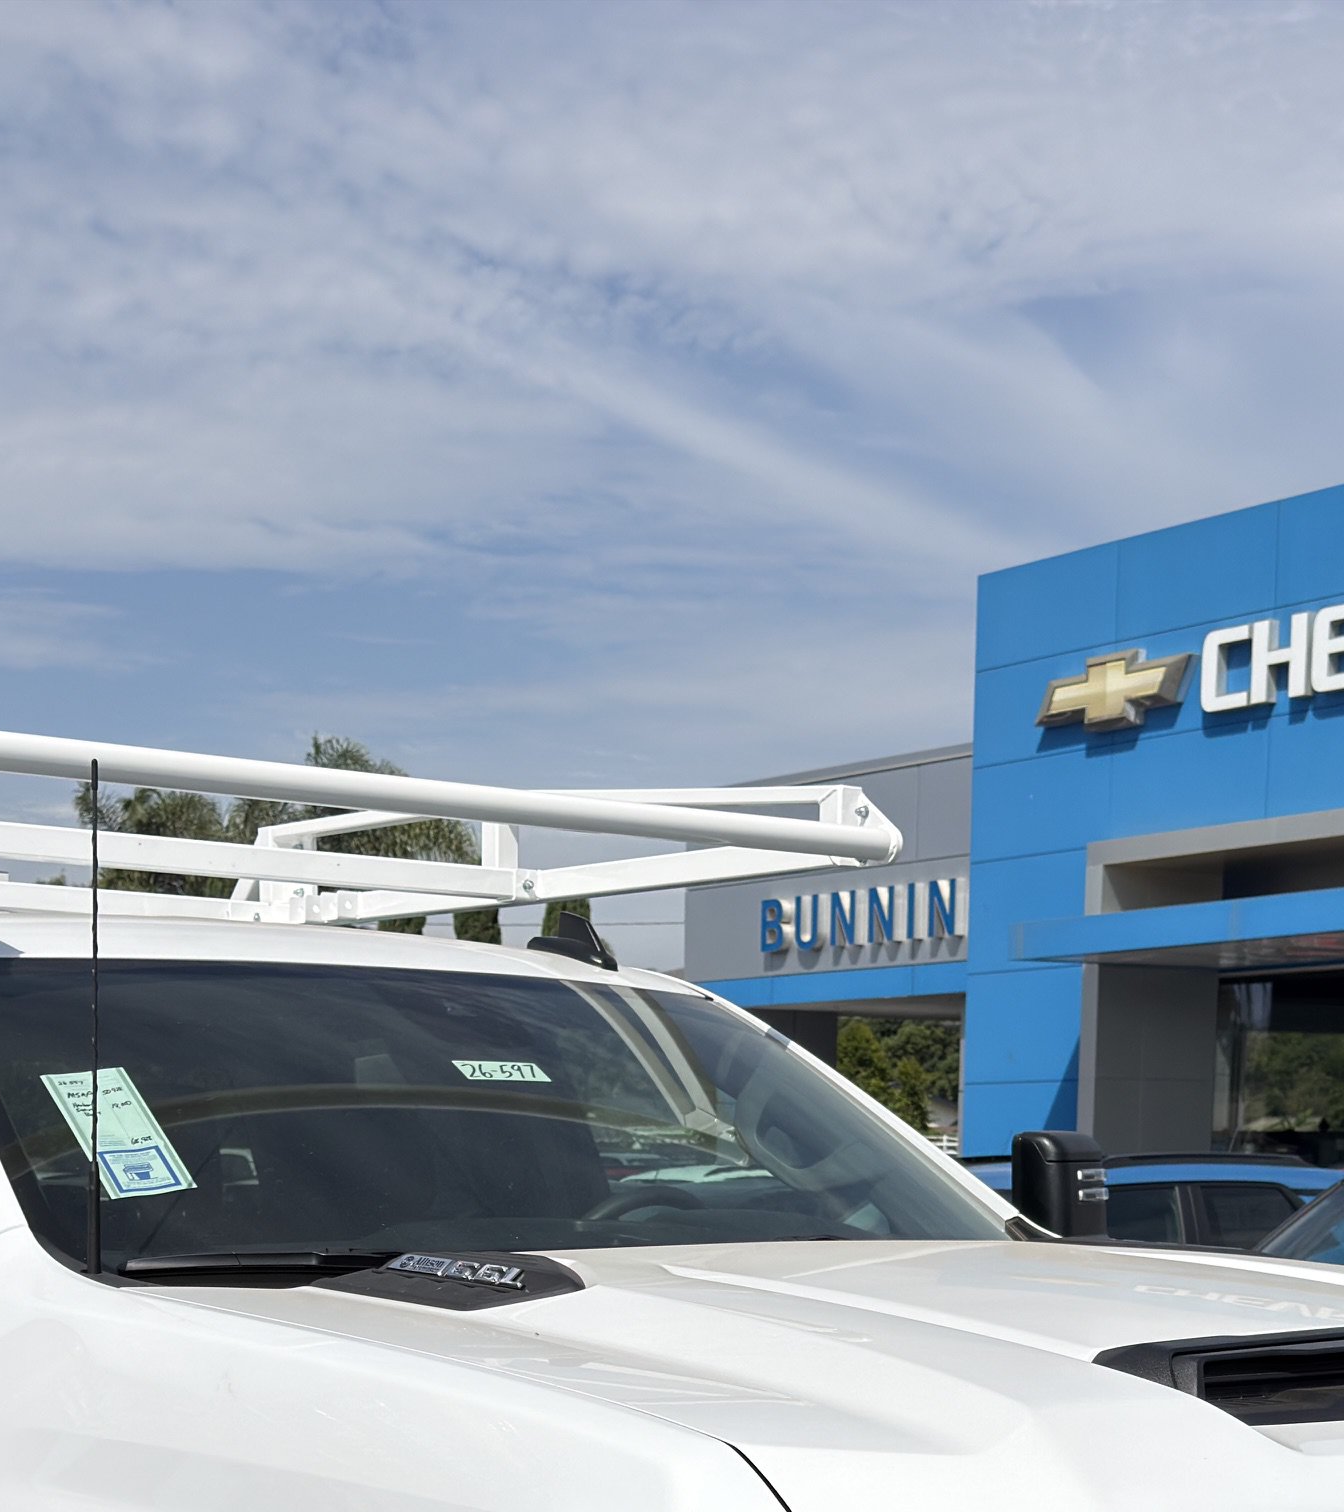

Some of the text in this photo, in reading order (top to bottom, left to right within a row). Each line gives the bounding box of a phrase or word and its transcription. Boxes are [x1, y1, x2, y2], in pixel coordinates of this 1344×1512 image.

[760, 878, 964, 953] BUNNIN
[460, 1063, 536, 1079] 26-597
[412, 1256, 446, 1268] Allison
